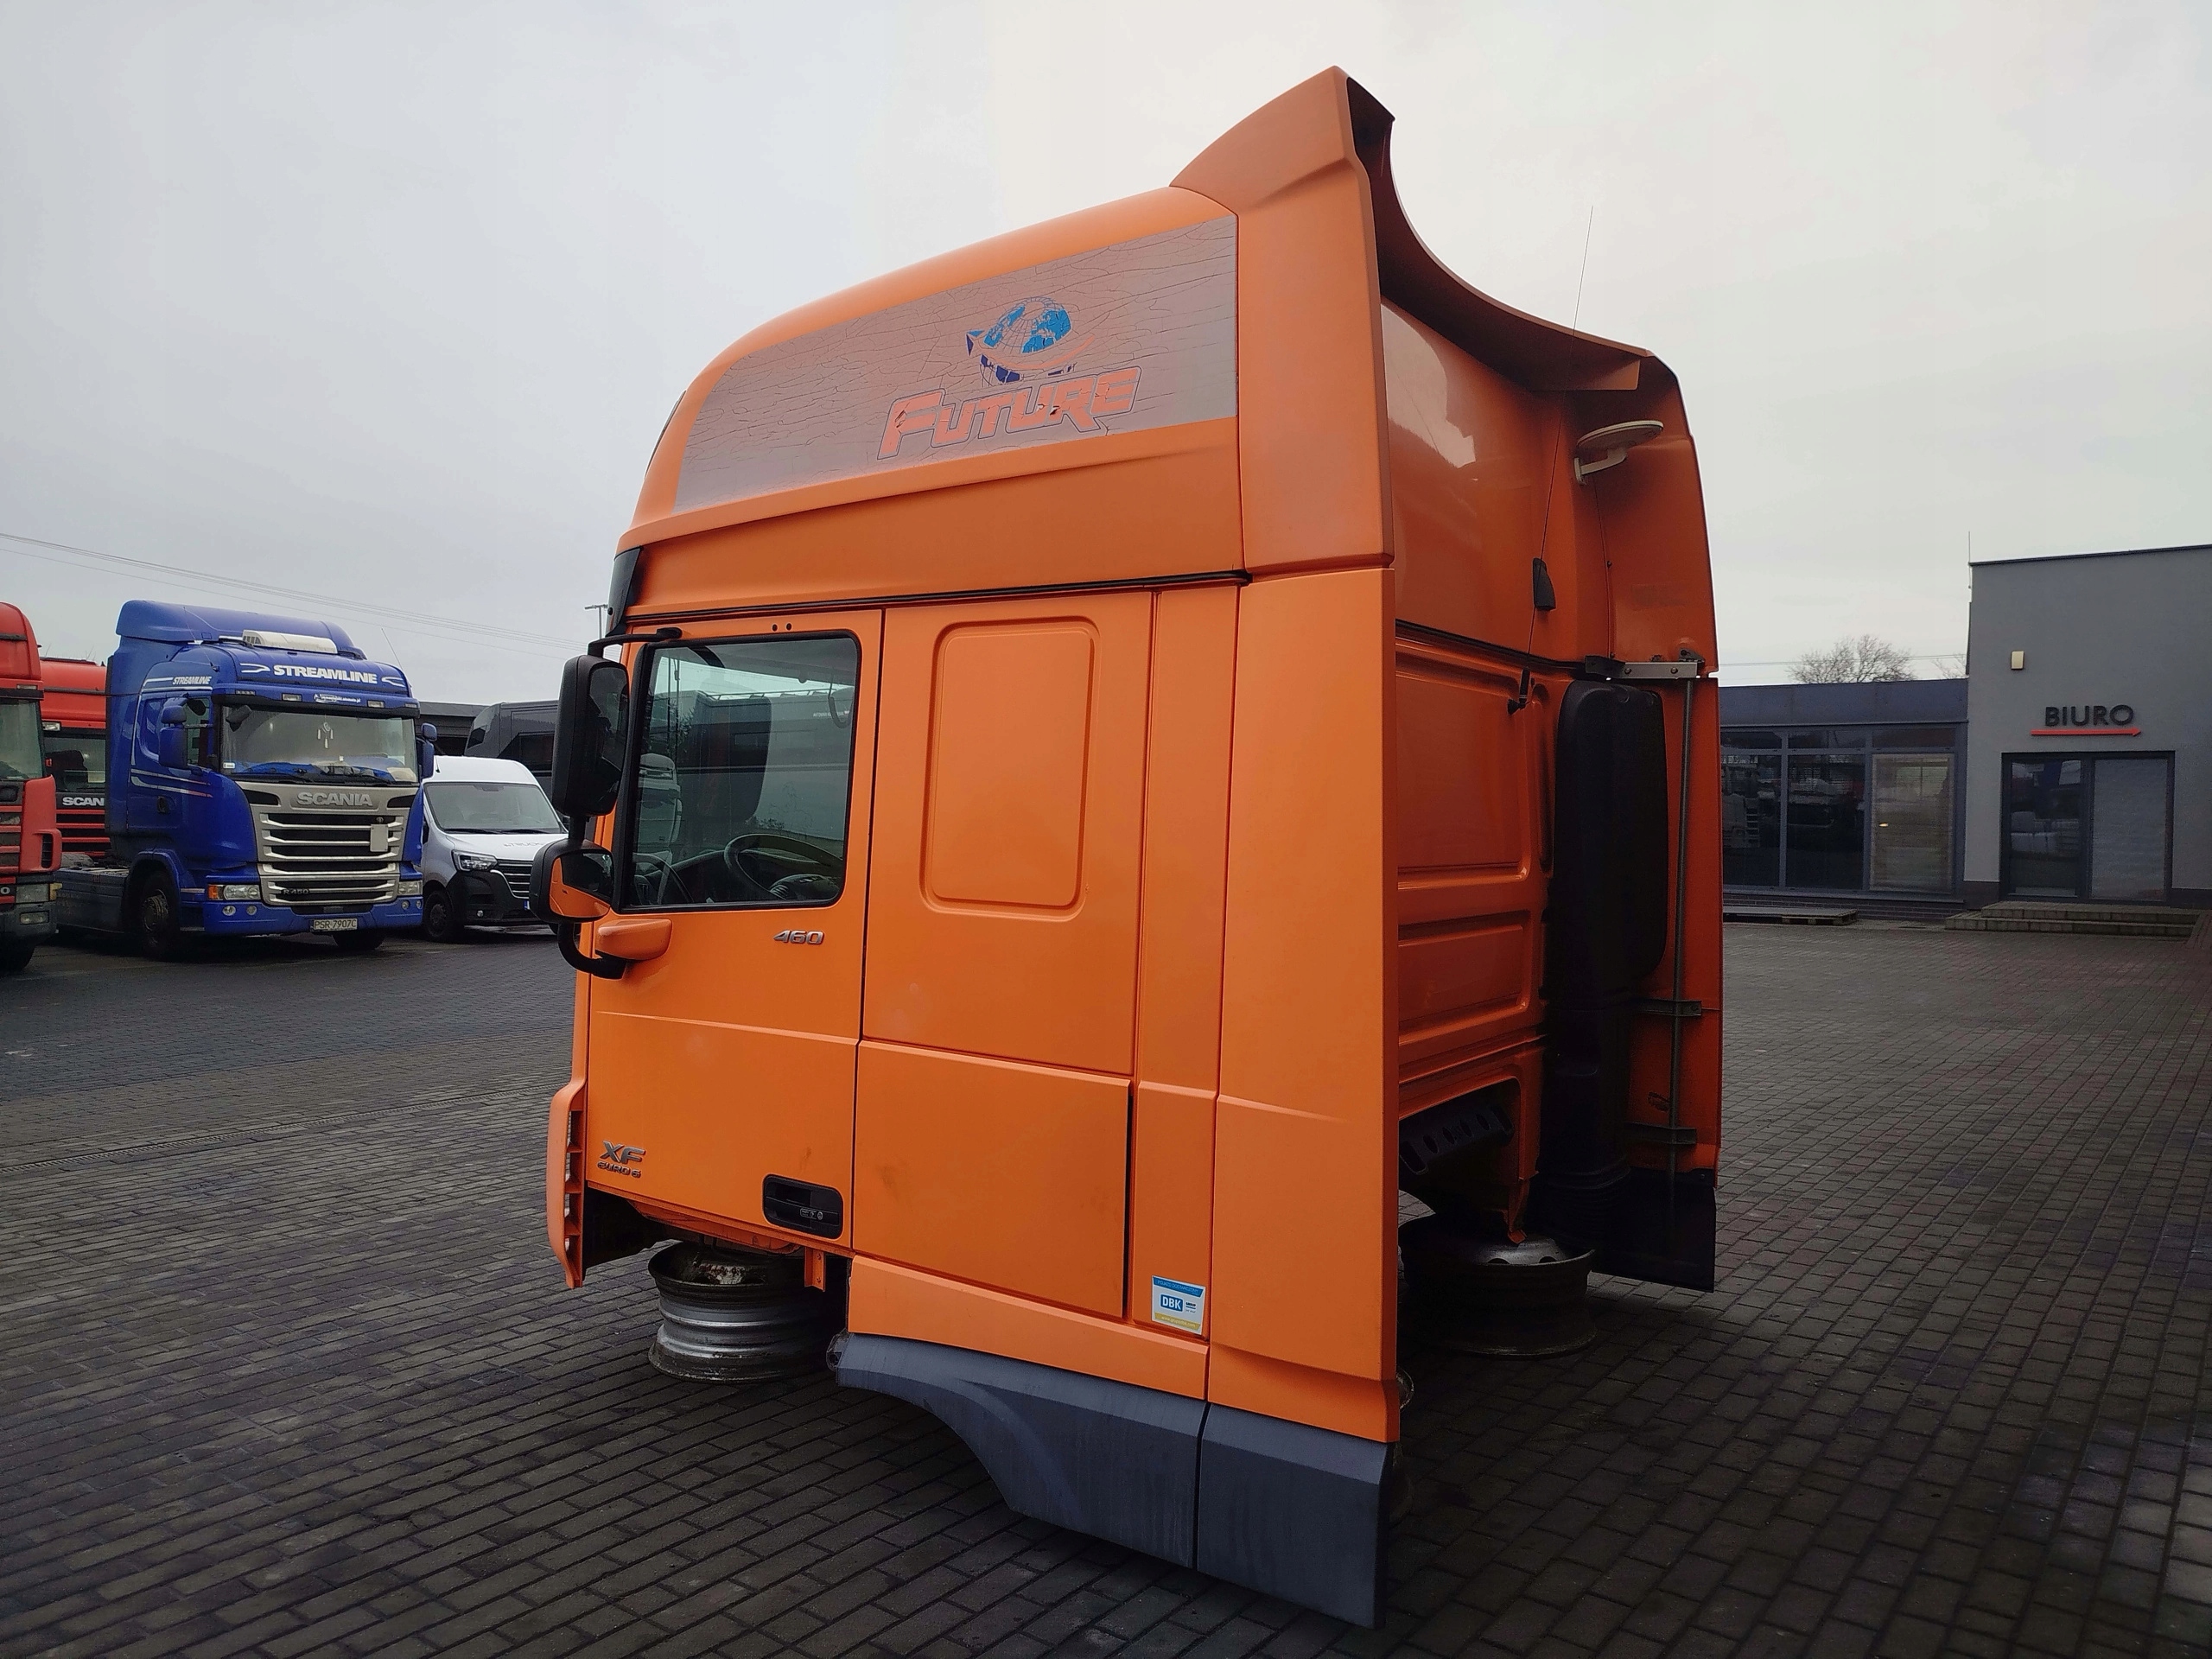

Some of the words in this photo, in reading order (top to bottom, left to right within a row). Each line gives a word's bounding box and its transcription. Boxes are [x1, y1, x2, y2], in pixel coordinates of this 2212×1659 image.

[878, 366, 1141, 459] FUTURE
[173, 676, 213, 685] STREAMLINE
[273, 664, 378, 684] STREAMLINE
[2044, 704, 2134, 727] BIURO
[62, 797, 105, 806] SCAN
[296, 791, 373, 807] SCANIA
[315, 920, 330, 929] PSR
[773, 930, 824, 944] 460
[600, 1140, 646, 1165] XF
[597, 1161, 630, 1175] EURO
[631, 1169, 642, 1179] 6
[1162, 1296, 1181, 1310] DBK
